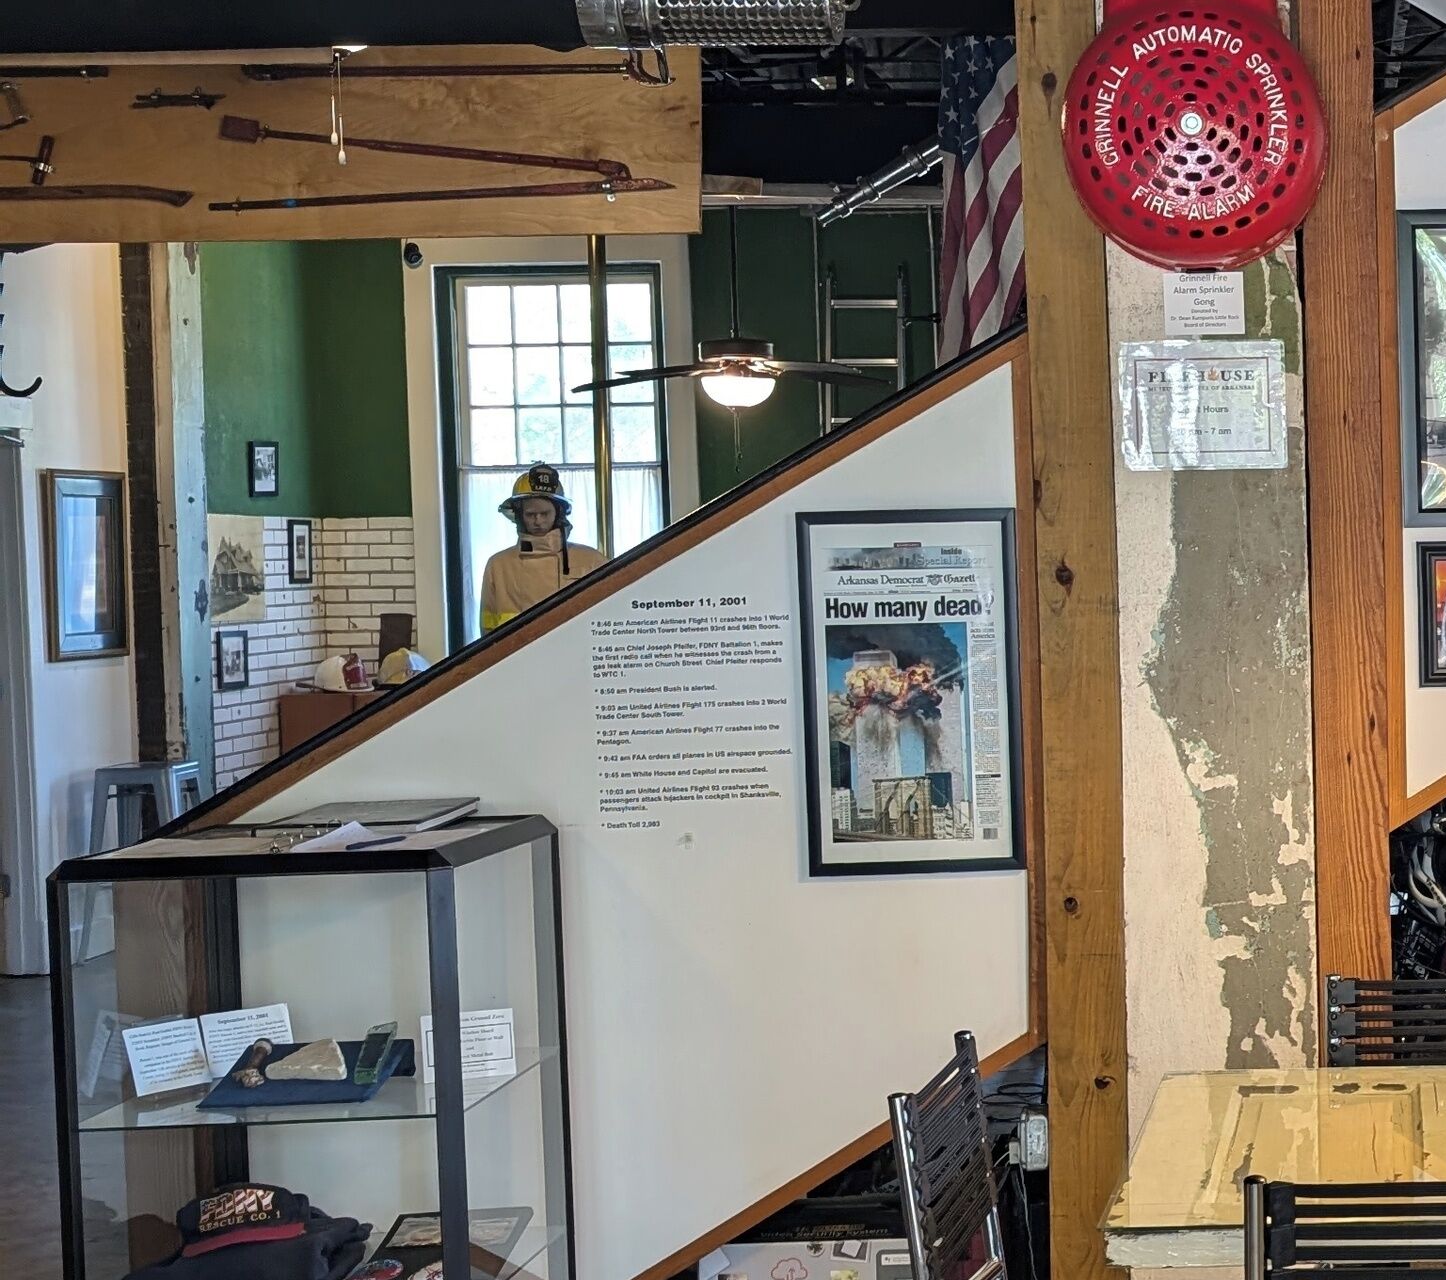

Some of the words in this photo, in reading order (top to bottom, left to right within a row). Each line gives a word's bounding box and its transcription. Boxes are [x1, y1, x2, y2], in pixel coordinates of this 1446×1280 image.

[1094, 65, 1129, 167] GRINNELL
[1132, 25, 1243, 60] AUTOMATIC
[1245, 53, 1289, 166] SPRINKLER
[1131, 184, 1179, 219] FIRE
[1187, 183, 1256, 221] ALARM
[1179, 274, 1210, 283] Grinnell
[1173, 286, 1197, 294] Alarm
[1199, 286, 1235, 296] Sprinkler
[1193, 298, 1215, 307] Gong
[1203, 405, 1229, 413] Hours
[917, 557, 953, 567] Special
[837, 574, 879, 586] Arkansas
[880, 573, 925, 585] Democrat
[632, 599, 695, 611] September
[699, 598, 716, 608] 11,
[720, 597, 746, 606] 2001
[825, 597, 869, 619] How
[874, 600, 928, 621] many
[200, 1188, 275, 1224] FDNY
[199, 1215, 245, 1232] RESCUE
[250, 1212, 271, 1221] CO.
[276, 1209, 281, 1219] 1
